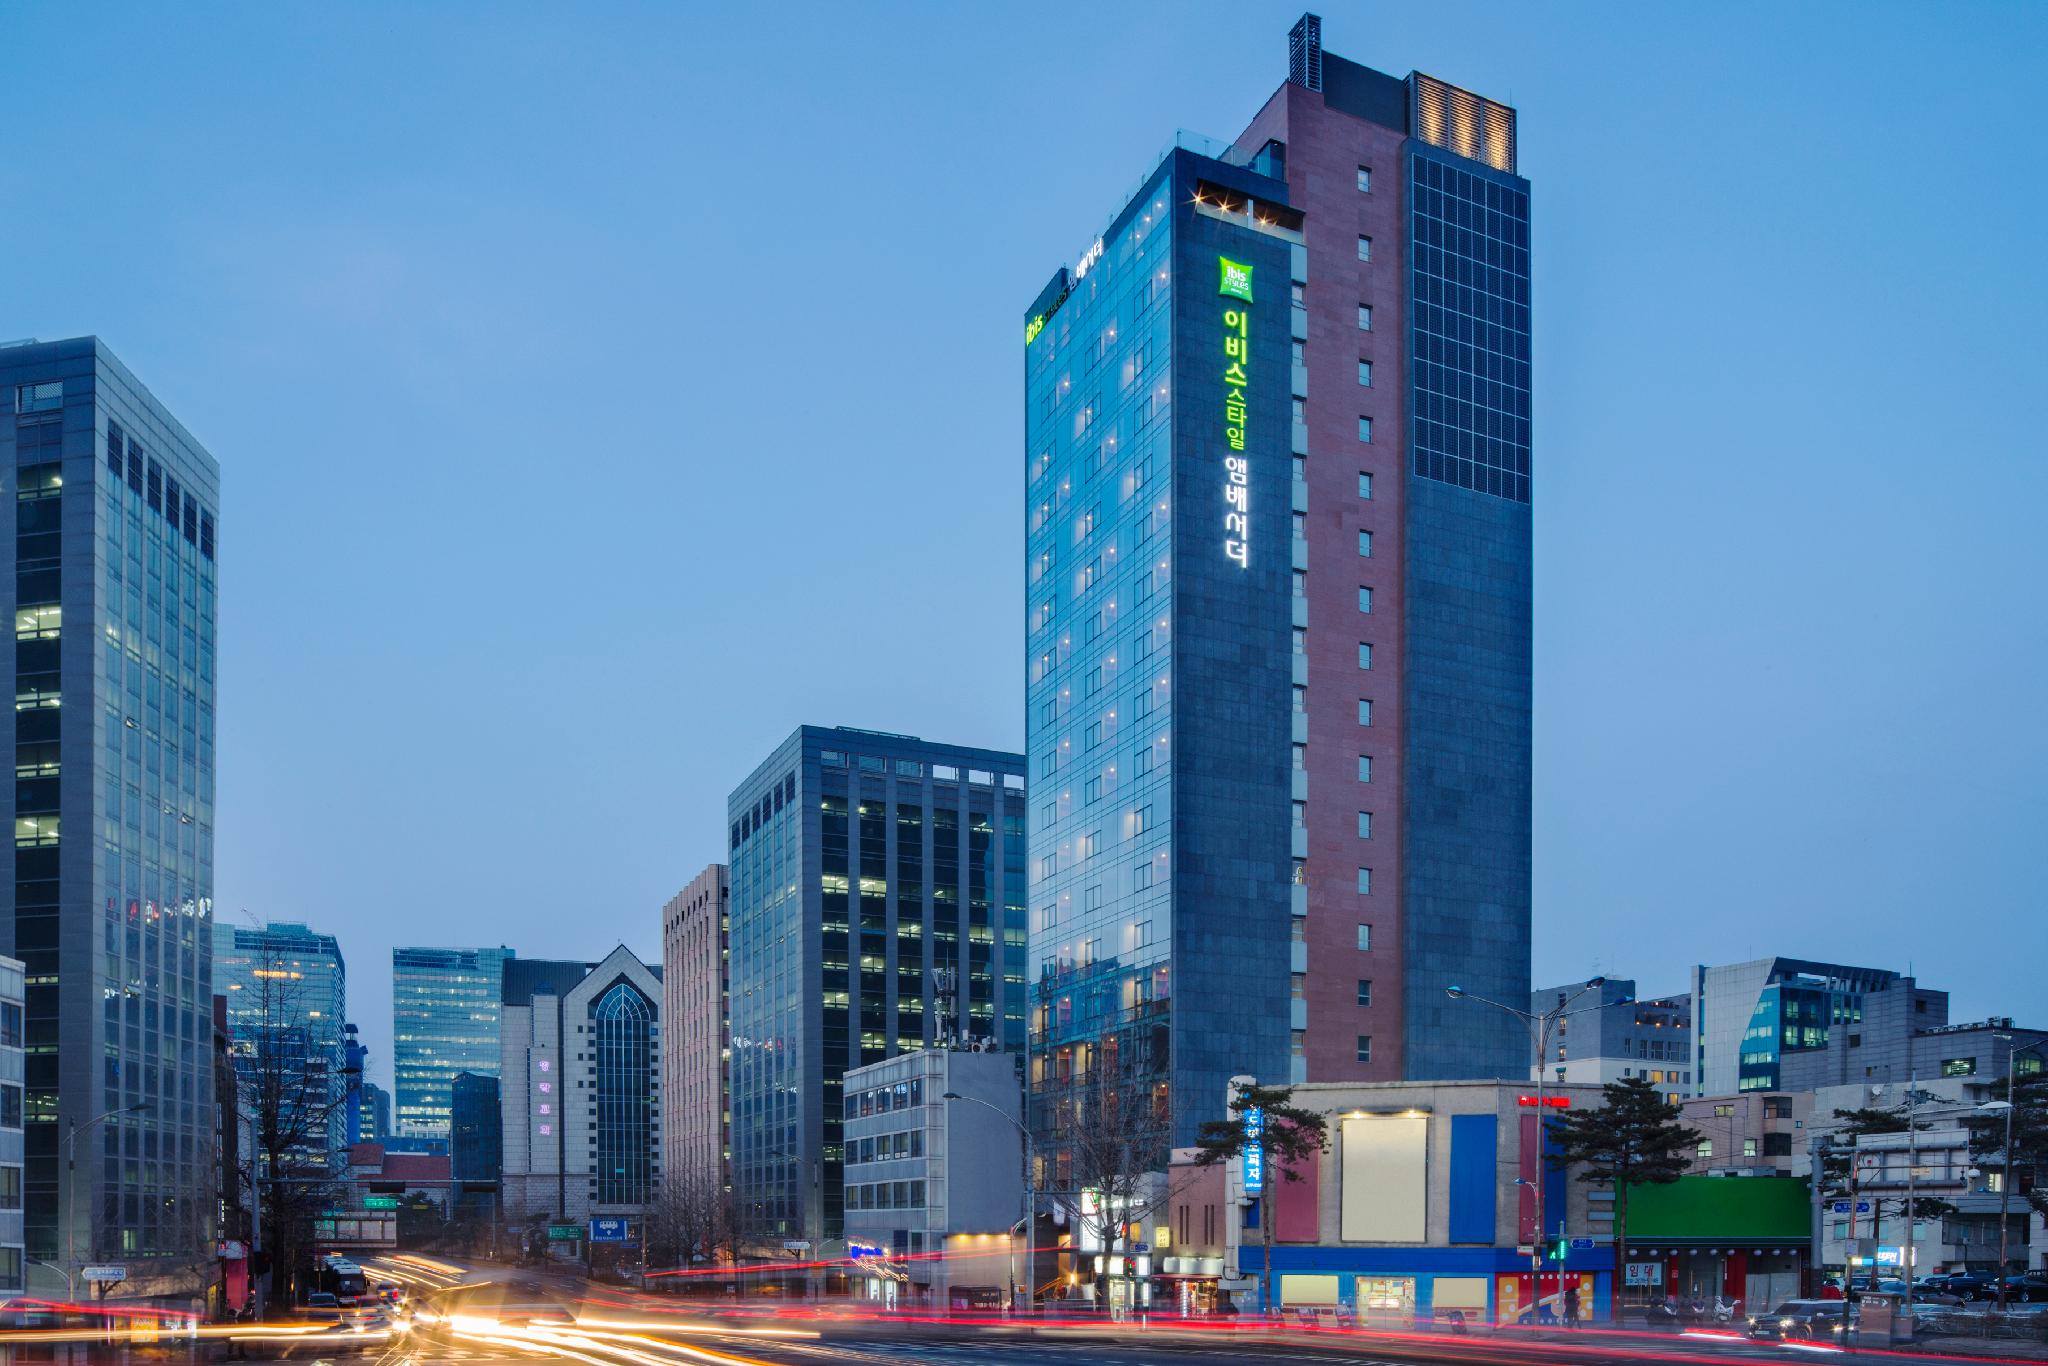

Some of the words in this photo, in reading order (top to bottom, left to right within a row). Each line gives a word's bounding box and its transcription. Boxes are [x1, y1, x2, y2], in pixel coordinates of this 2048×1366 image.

[1226, 265, 1246, 282] ibis
[1026, 314, 1043, 346] ibis
[1224, 311, 1248, 387] 이비스
[1226, 387, 1248, 450] 스타일
[1225, 456, 1247, 569] 앰배서더
